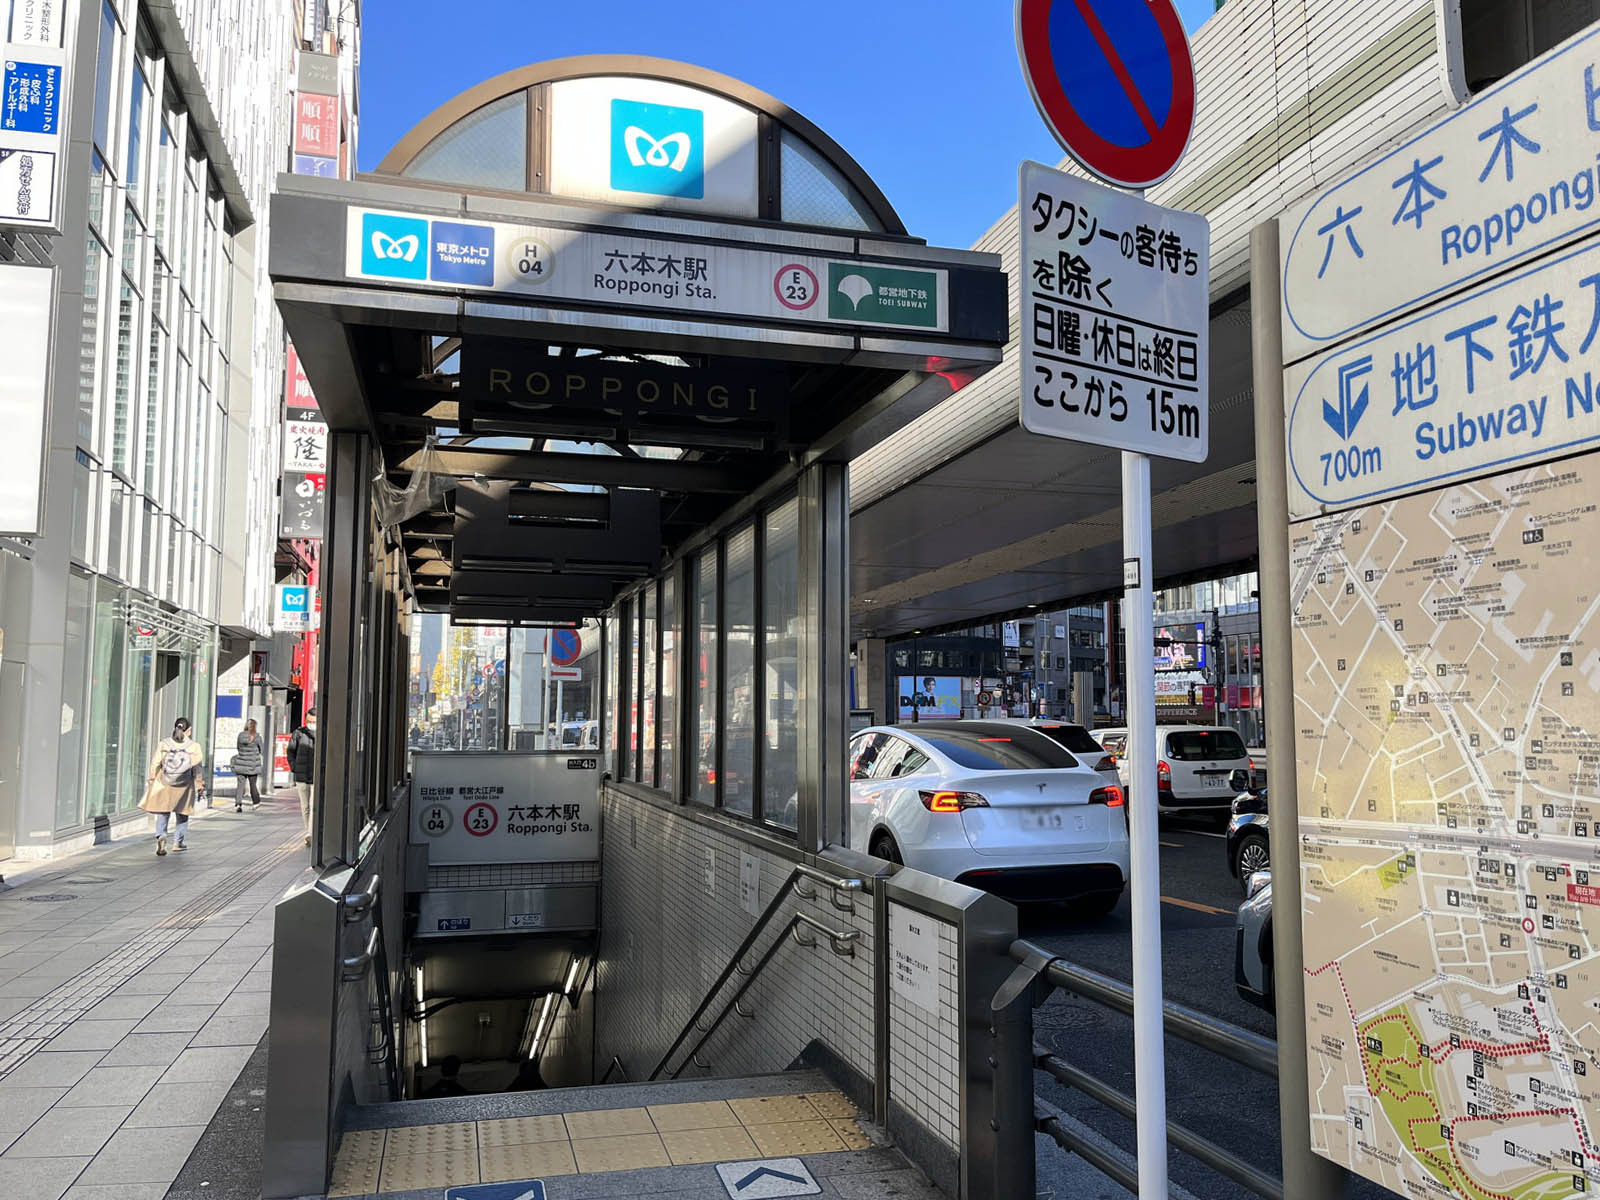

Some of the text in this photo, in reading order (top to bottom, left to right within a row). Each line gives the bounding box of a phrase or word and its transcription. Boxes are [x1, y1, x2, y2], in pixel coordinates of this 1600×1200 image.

[43, 67, 56, 131] さとうクリニック
[17, 155, 33, 216] 処方せん受付
[1032, 192, 1198, 276] タクシーの客待ち
[436, 241, 489, 258] 東京メトロ
[524, 244, 538, 259] H
[439, 253, 487, 266] Tokyo Metro
[518, 258, 543, 275] 04
[604, 249, 708, 282] 六本木駅
[594, 273, 717, 300] Roppongi Sta.
[792, 272, 801, 285] E
[1032, 250, 1113, 308] を除く
[785, 285, 808, 301] 23
[878, 286, 928, 300] 都営地下鉄
[878, 298, 928, 310] TOEI SUBWAY
[1033, 302, 1198, 382] 日曜・休日は終日
[489, 367, 758, 411] ROPPONGI
[1033, 365, 1200, 439] ここから 15m
[299, 411, 317, 421] 4F
[1415, 394, 1548, 461] Subway
[294, 436, 324, 461] 隆
[1320, 444, 1382, 487] 700m
[582, 759, 596, 769] 4b
[420, 787, 504, 796] 日比谷線 都営大江戸線
[432, 808, 441, 818] H
[478, 808, 485, 818] E
[507, 804, 580, 822] 六本木駅
[427, 820, 445, 831] 04
[473, 819, 489, 830] 23
[507, 821, 593, 836] Roppongi Sta.
